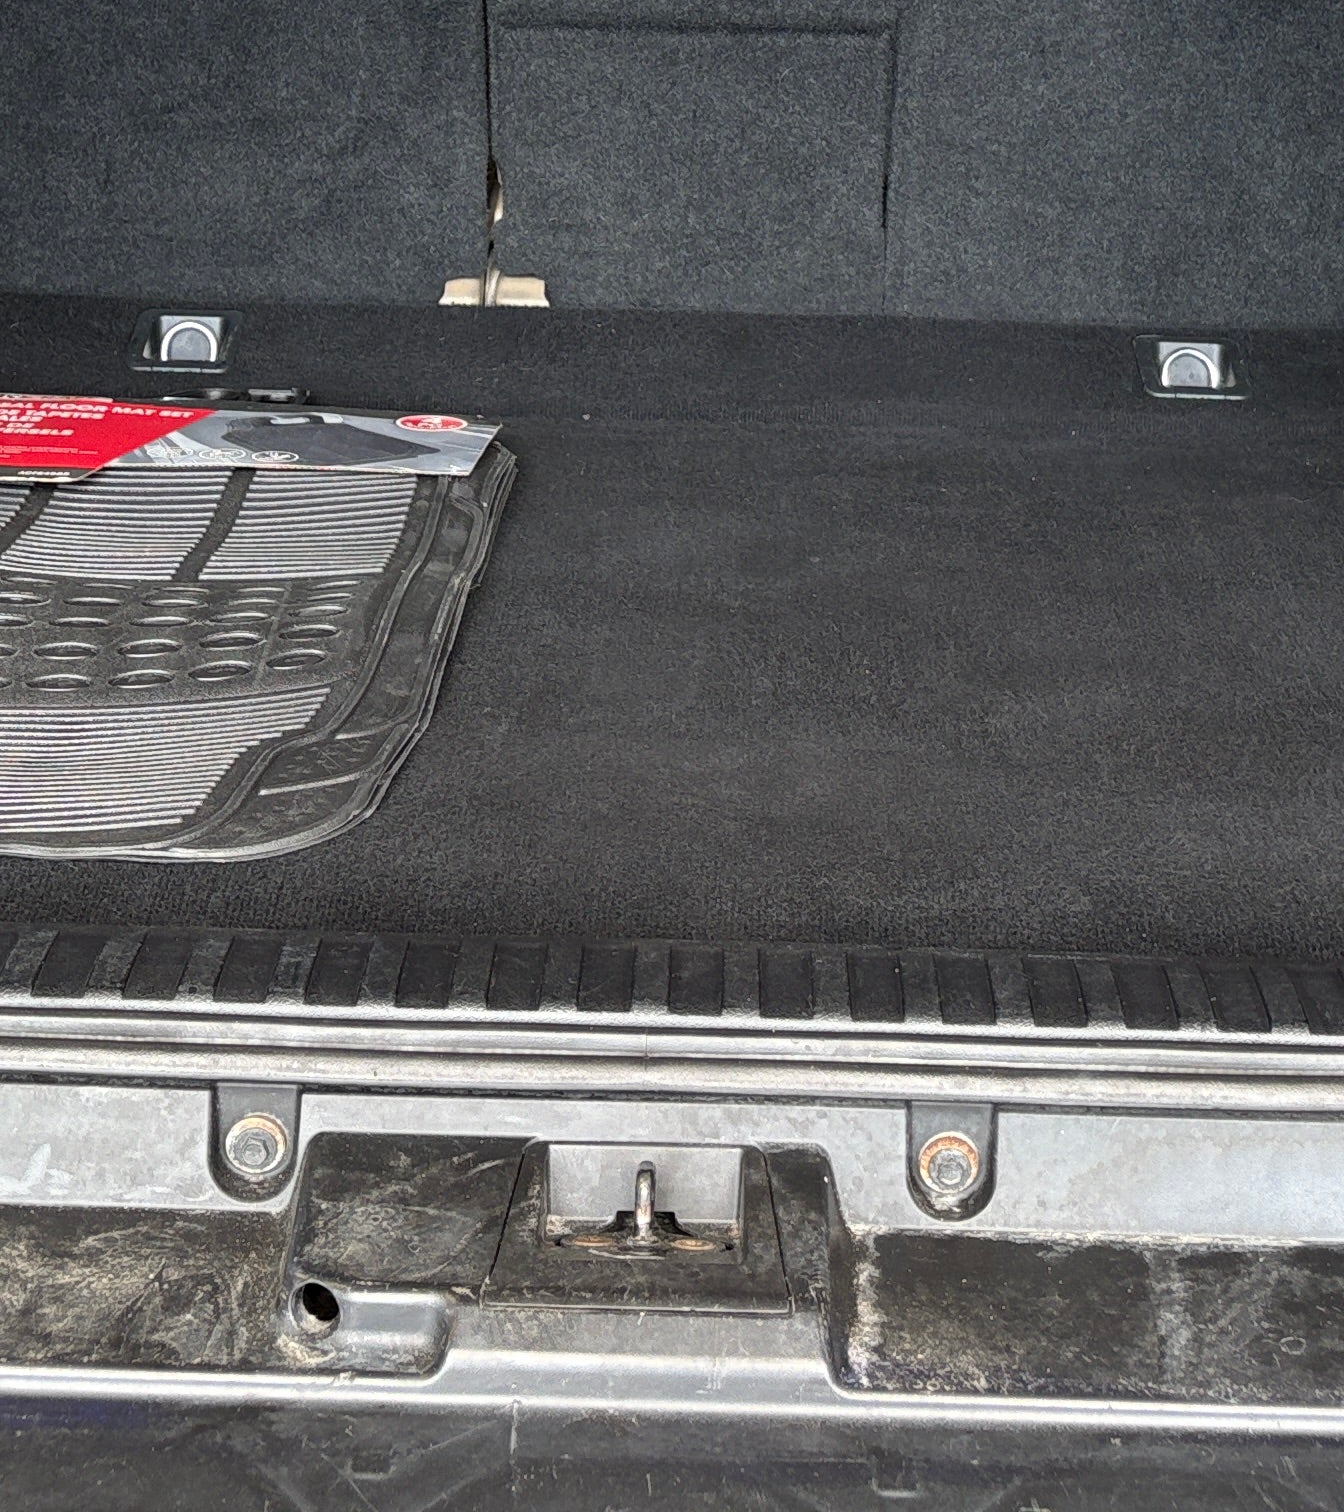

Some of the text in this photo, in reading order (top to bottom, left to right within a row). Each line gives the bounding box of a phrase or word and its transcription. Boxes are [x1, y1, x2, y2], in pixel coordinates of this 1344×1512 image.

[26, 410, 106, 420] TAPETES
[40, 402, 109, 412] FLOOR
[112, 406, 156, 416] MAT
[159, 410, 194, 419] SET
